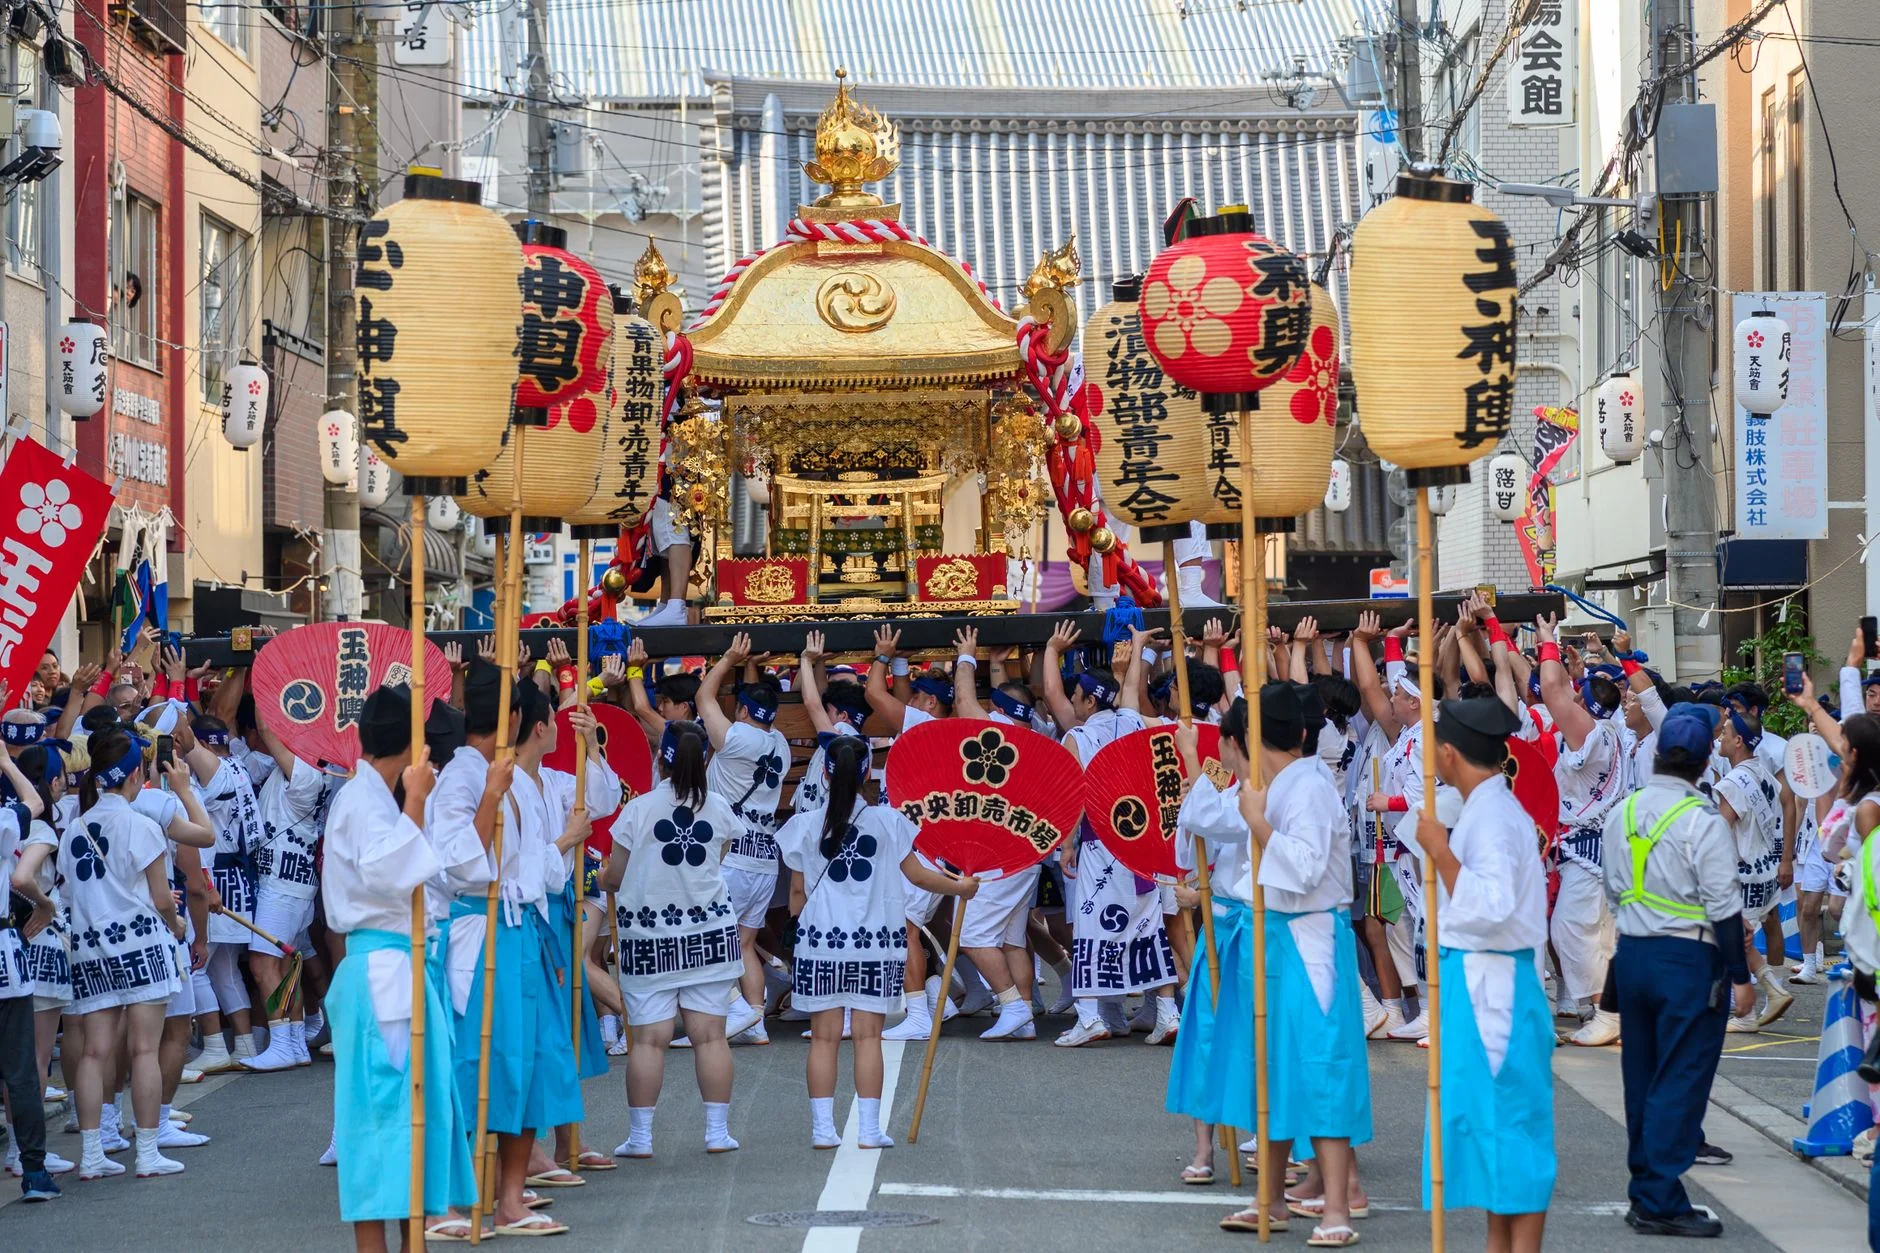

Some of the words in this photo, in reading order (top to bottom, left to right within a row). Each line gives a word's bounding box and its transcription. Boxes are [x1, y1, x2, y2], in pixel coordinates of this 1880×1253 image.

[901, 793, 1059, 850] 中央卸売市場
